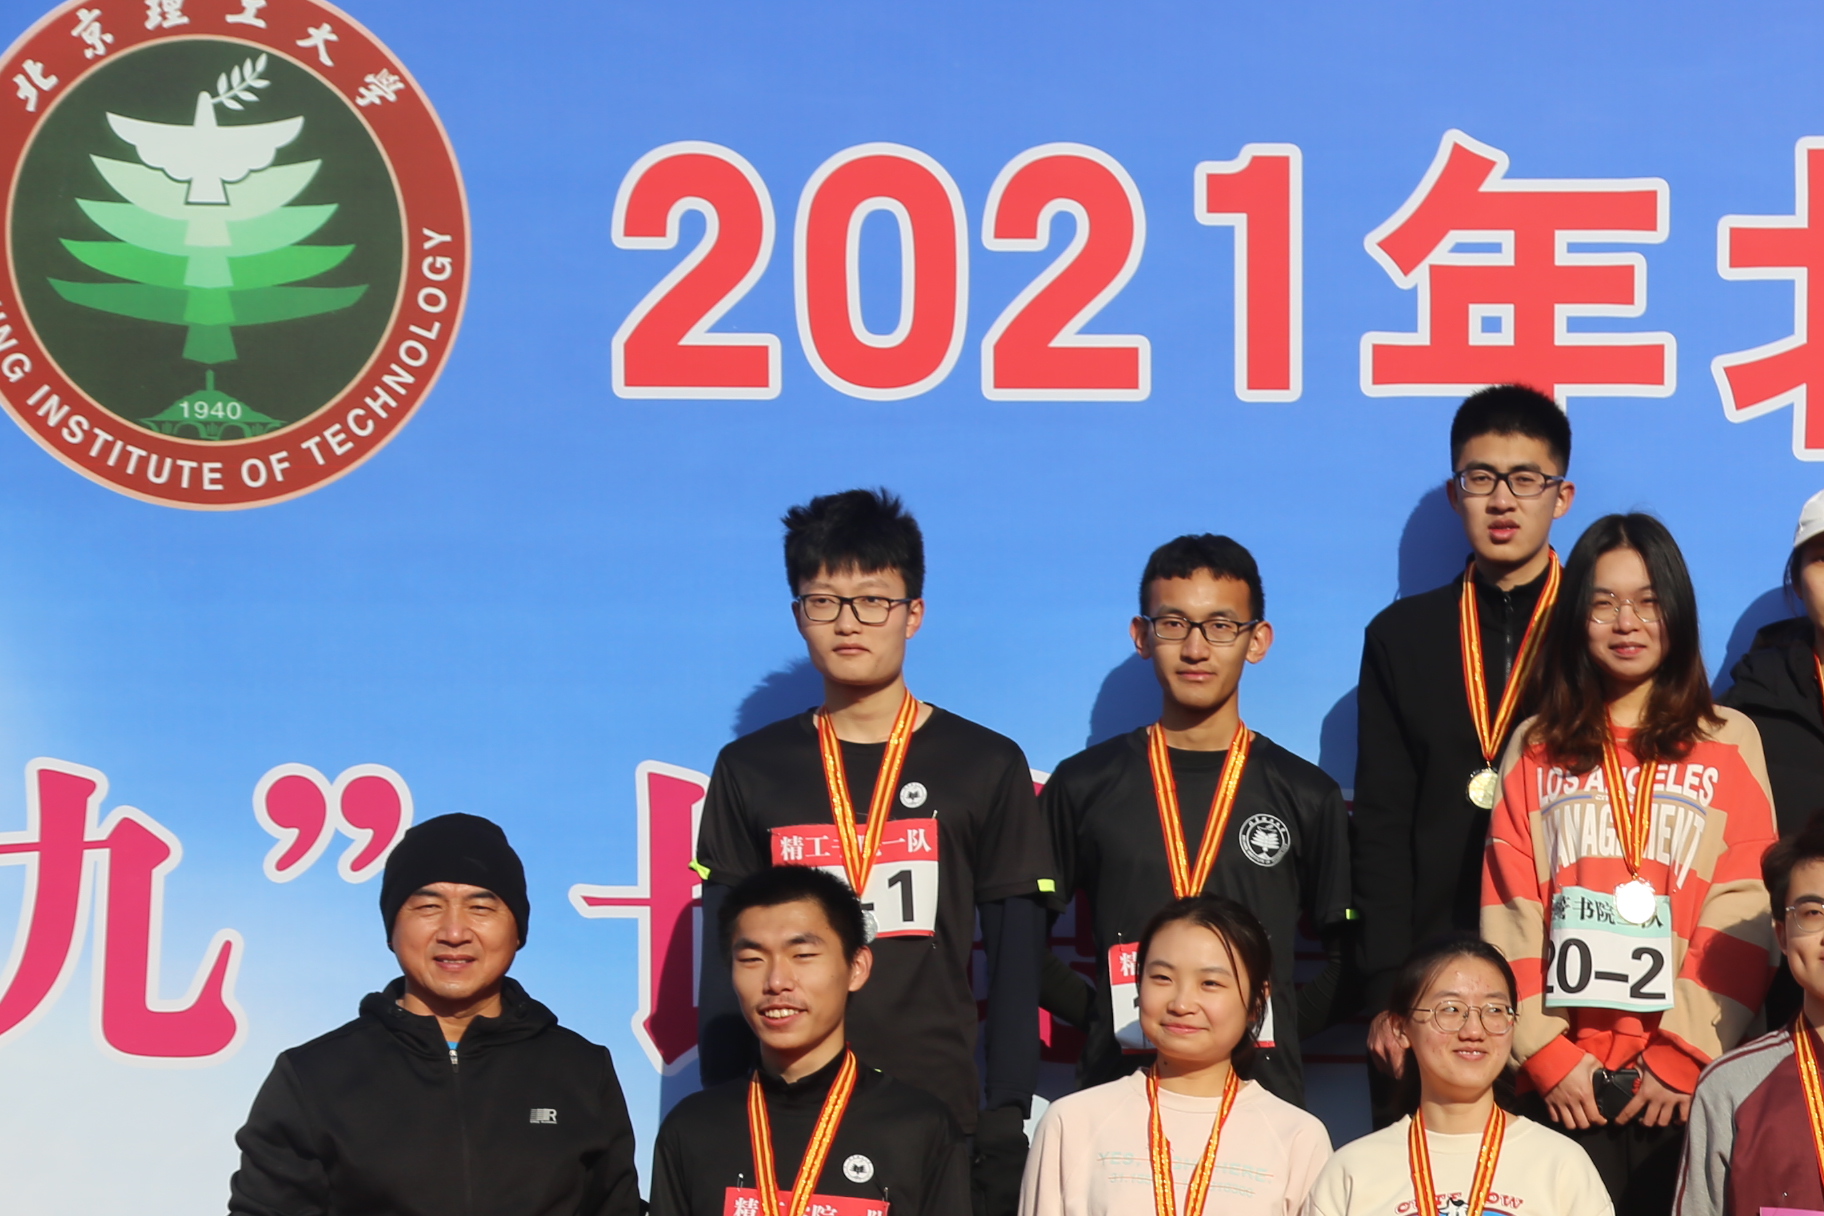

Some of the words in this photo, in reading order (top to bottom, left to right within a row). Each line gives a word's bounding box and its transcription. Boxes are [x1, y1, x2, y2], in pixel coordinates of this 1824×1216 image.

[27, 384, 224, 490] INSTITUTE
[240, 451, 291, 488] OF
[301, 227, 453, 466] TECHNOLOGY
[179, 401, 241, 420] 1940
[1536, 766, 1579, 804] LOS
[1584, 763, 1719, 807] AGELES
